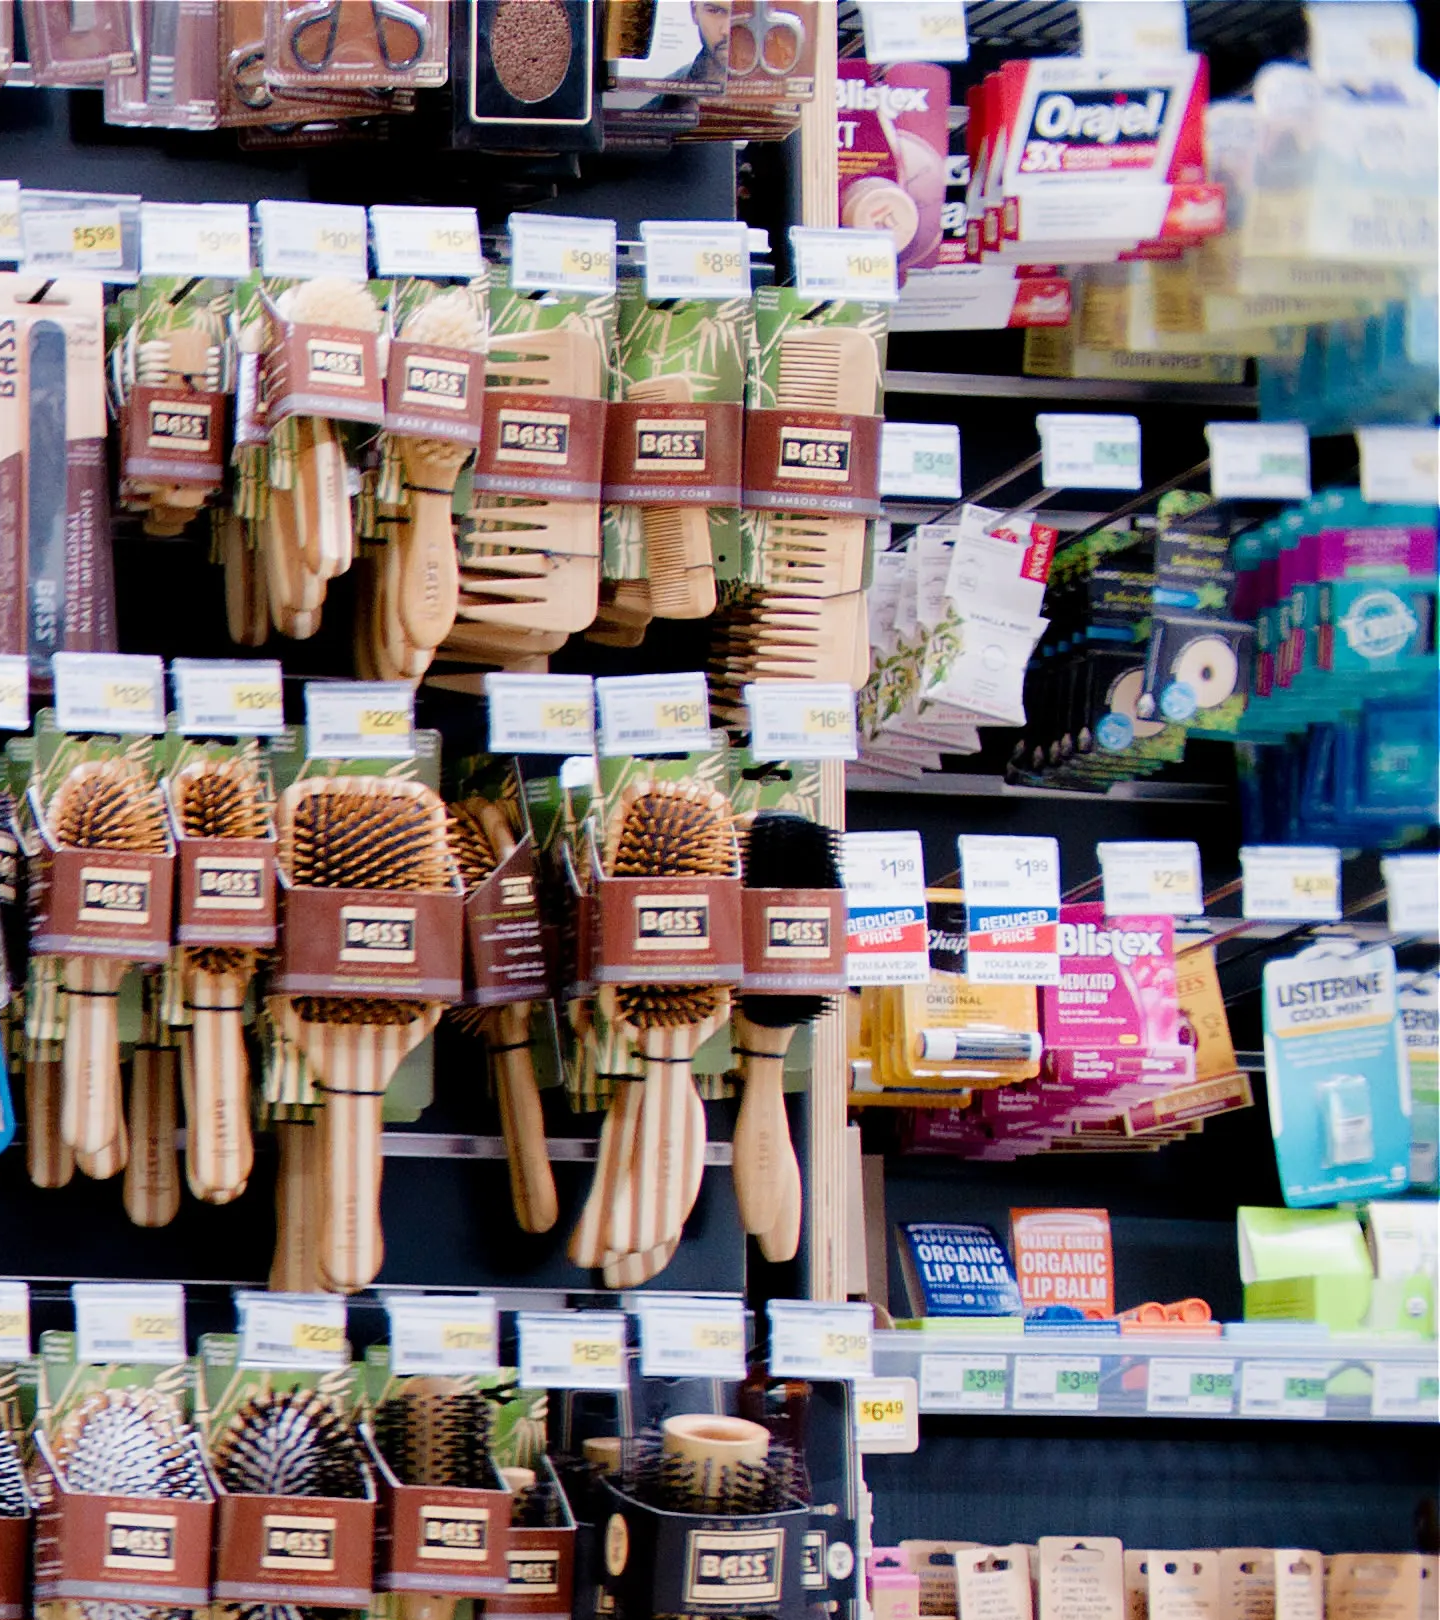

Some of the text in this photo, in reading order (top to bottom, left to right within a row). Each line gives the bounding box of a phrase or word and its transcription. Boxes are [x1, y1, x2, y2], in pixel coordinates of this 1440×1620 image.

[1034, 91, 1165, 144] Orajel
[1021, 142, 1062, 171] 3X
[503, 423, 559, 447] BASS
[641, 431, 697, 454] BASS
[785, 440, 841, 464] BASS
[489, 478, 574, 495] BAMBOO COMB
[628, 488, 712, 500] BAMBOO COMB
[770, 494, 855, 510] BAMBOO COMB
[64, 512, 81, 633] PROFESSIONAL
[35, 580, 58, 647] BASS
[200, 869, 258, 893] BASS
[86, 880, 145, 906] BASS
[641, 911, 702, 935] BASS
[847, 909, 916, 932] REDUCED
[979, 911, 1050, 932] REDUCED
[347, 922, 409, 948] BASS
[769, 922, 825, 945] BASS
[859, 927, 905, 947] PRICE
[991, 928, 1037, 947] PRICE
[1058, 923, 1164, 965] Blistex
[1058, 973, 1117, 991] MEDICATED
[1277, 971, 1385, 1008] LISTERINE
[926, 994, 983, 1006] ORIGINAL
[1291, 1006, 1330, 1023] COOL
[913, 1232, 996, 1246] PEPPERMINT
[1020, 1235, 1105, 1250] ORANGE GINGER
[917, 1244, 1005, 1265] ORGANIC
[1021, 1252, 1107, 1275] ORGANIC
[924, 1264, 1010, 1284] LIP BALM
[1022, 1276, 1107, 1300] LIP BALM
[111, 1527, 172, 1555] BASS
[269, 1531, 330, 1557] BASS
[426, 1520, 483, 1546] BASS
[512, 1560, 557, 1582] BASS
[699, 1552, 769, 1580] BASS
